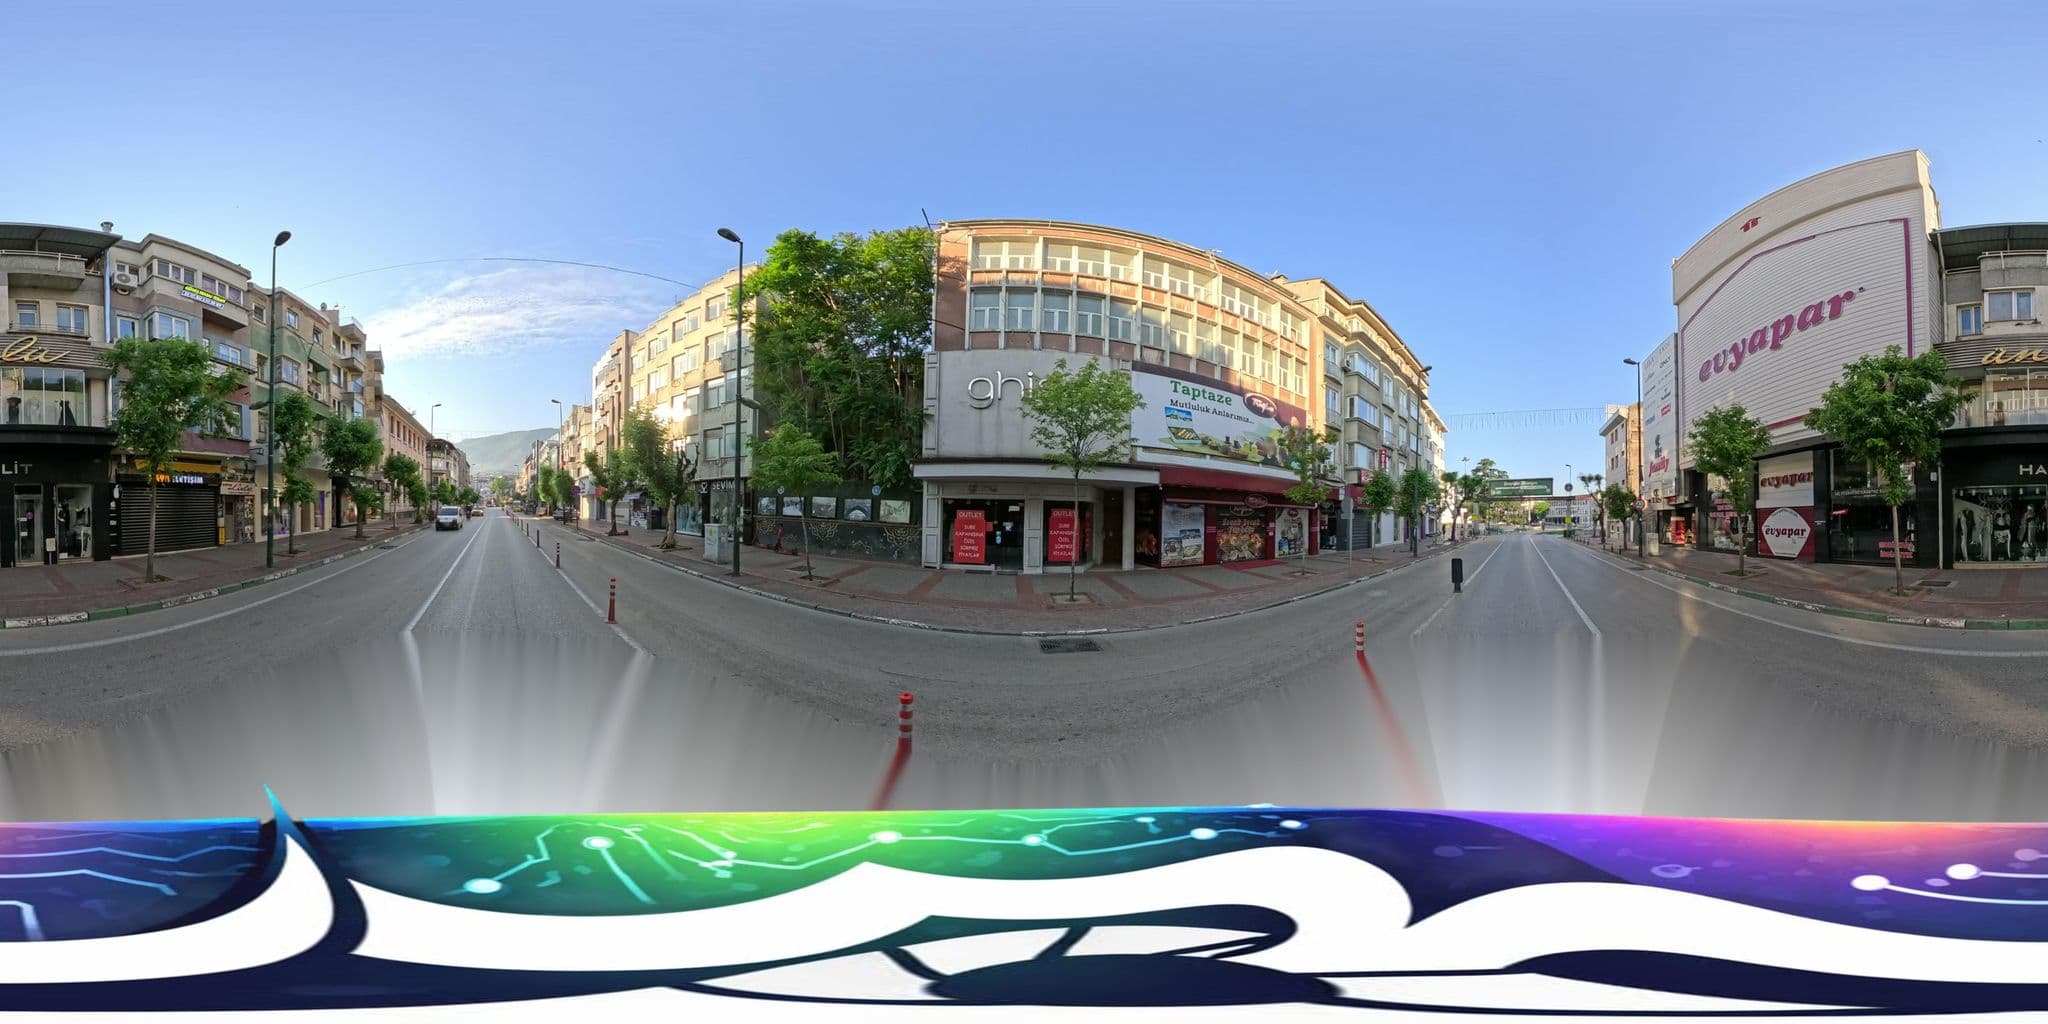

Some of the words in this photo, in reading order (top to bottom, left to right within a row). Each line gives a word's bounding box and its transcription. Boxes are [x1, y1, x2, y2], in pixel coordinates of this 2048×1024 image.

[1698, 290, 1856, 383] evyapar
[1170, 380, 1233, 406] Taptaze
[1170, 399, 1210, 413] Mutluluk
[1760, 472, 1813, 488] evyapar
[1765, 527, 1807, 539] evyapar
